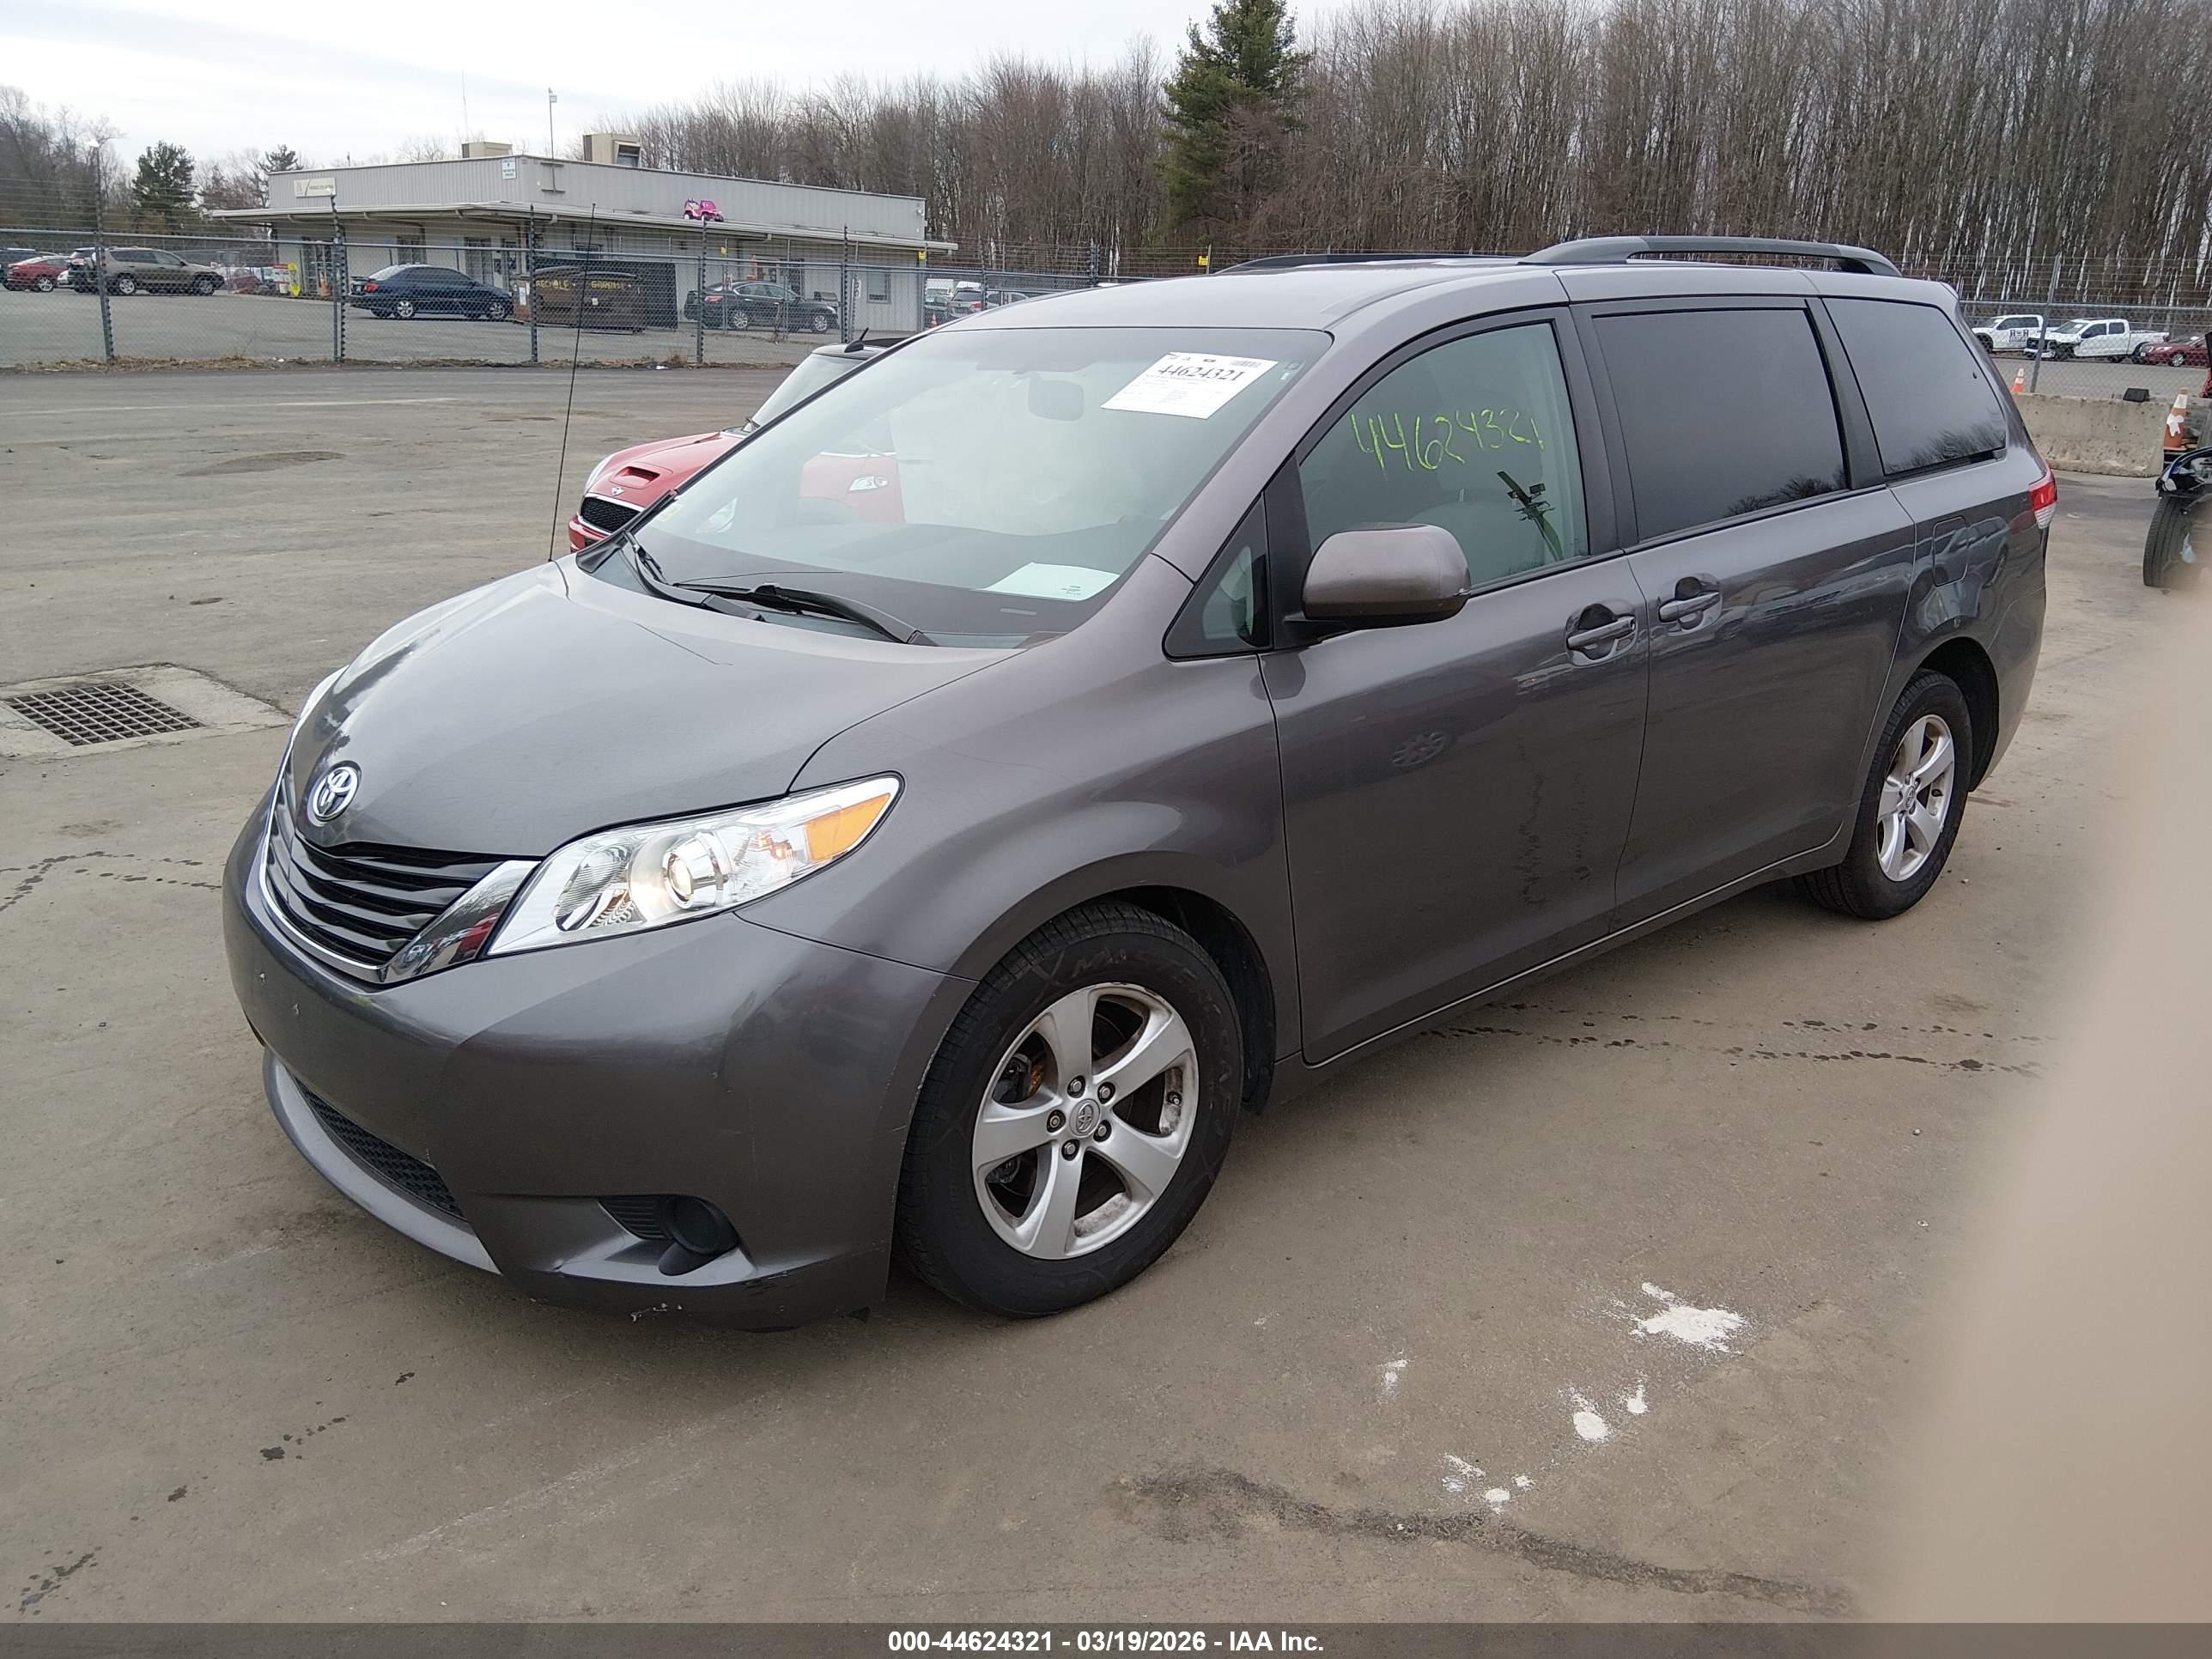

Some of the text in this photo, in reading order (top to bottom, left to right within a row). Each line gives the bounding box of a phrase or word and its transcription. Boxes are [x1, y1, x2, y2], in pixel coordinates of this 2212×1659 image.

[592, 280, 624, 289] GARBA
[1158, 364, 1246, 381] 44624321
[1350, 408, 1545, 471] 44624321
